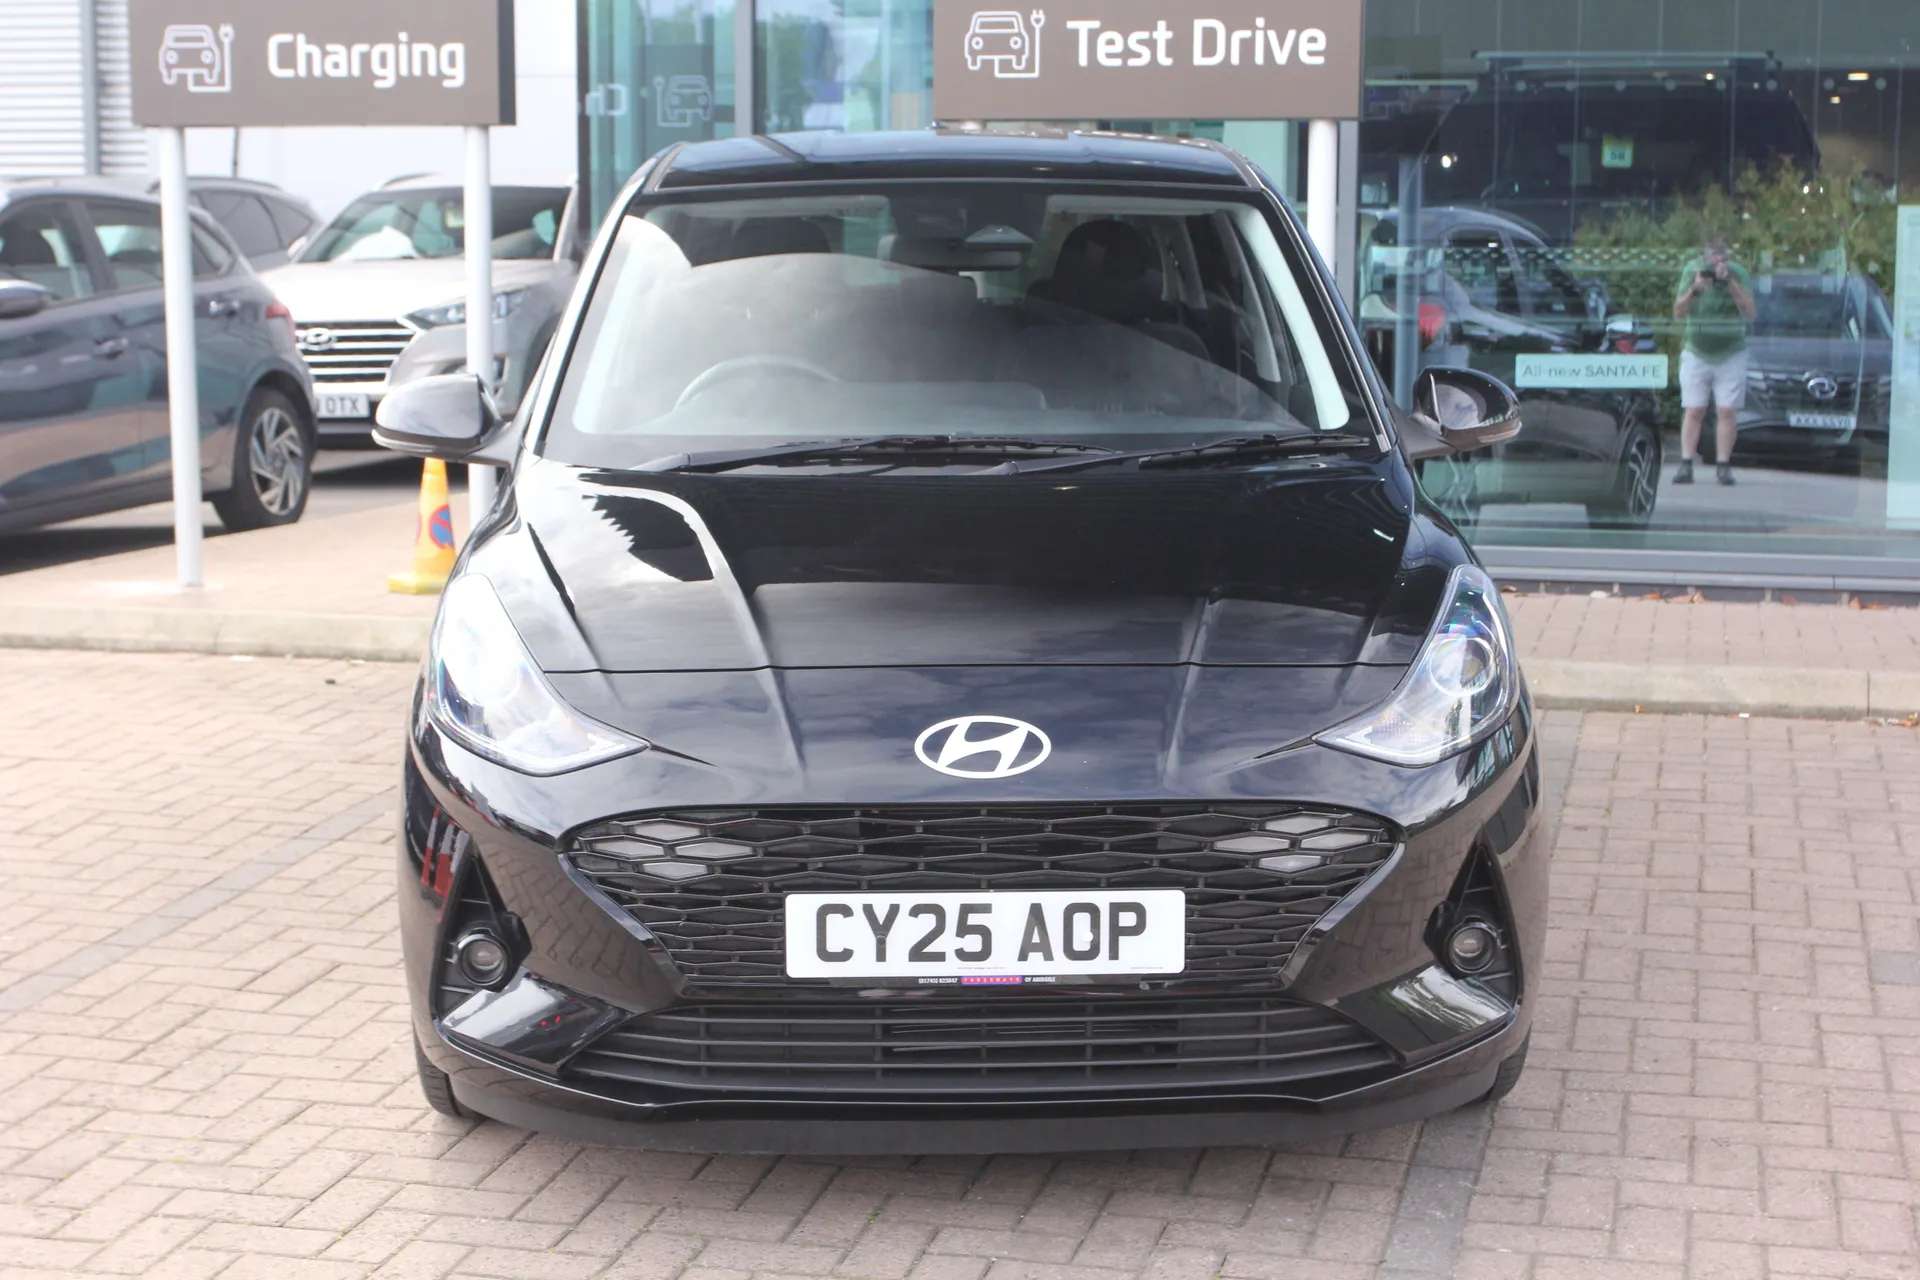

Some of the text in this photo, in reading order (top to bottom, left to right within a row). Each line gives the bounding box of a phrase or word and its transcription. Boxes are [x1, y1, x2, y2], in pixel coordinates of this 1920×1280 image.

[267, 31, 466, 88] Charging
[1066, 17, 1327, 67] Test Drive
[1585, 364, 1637, 378] SANTA
[1642, 364, 1661, 378] FE
[815, 901, 1147, 963] CY25 AOP
